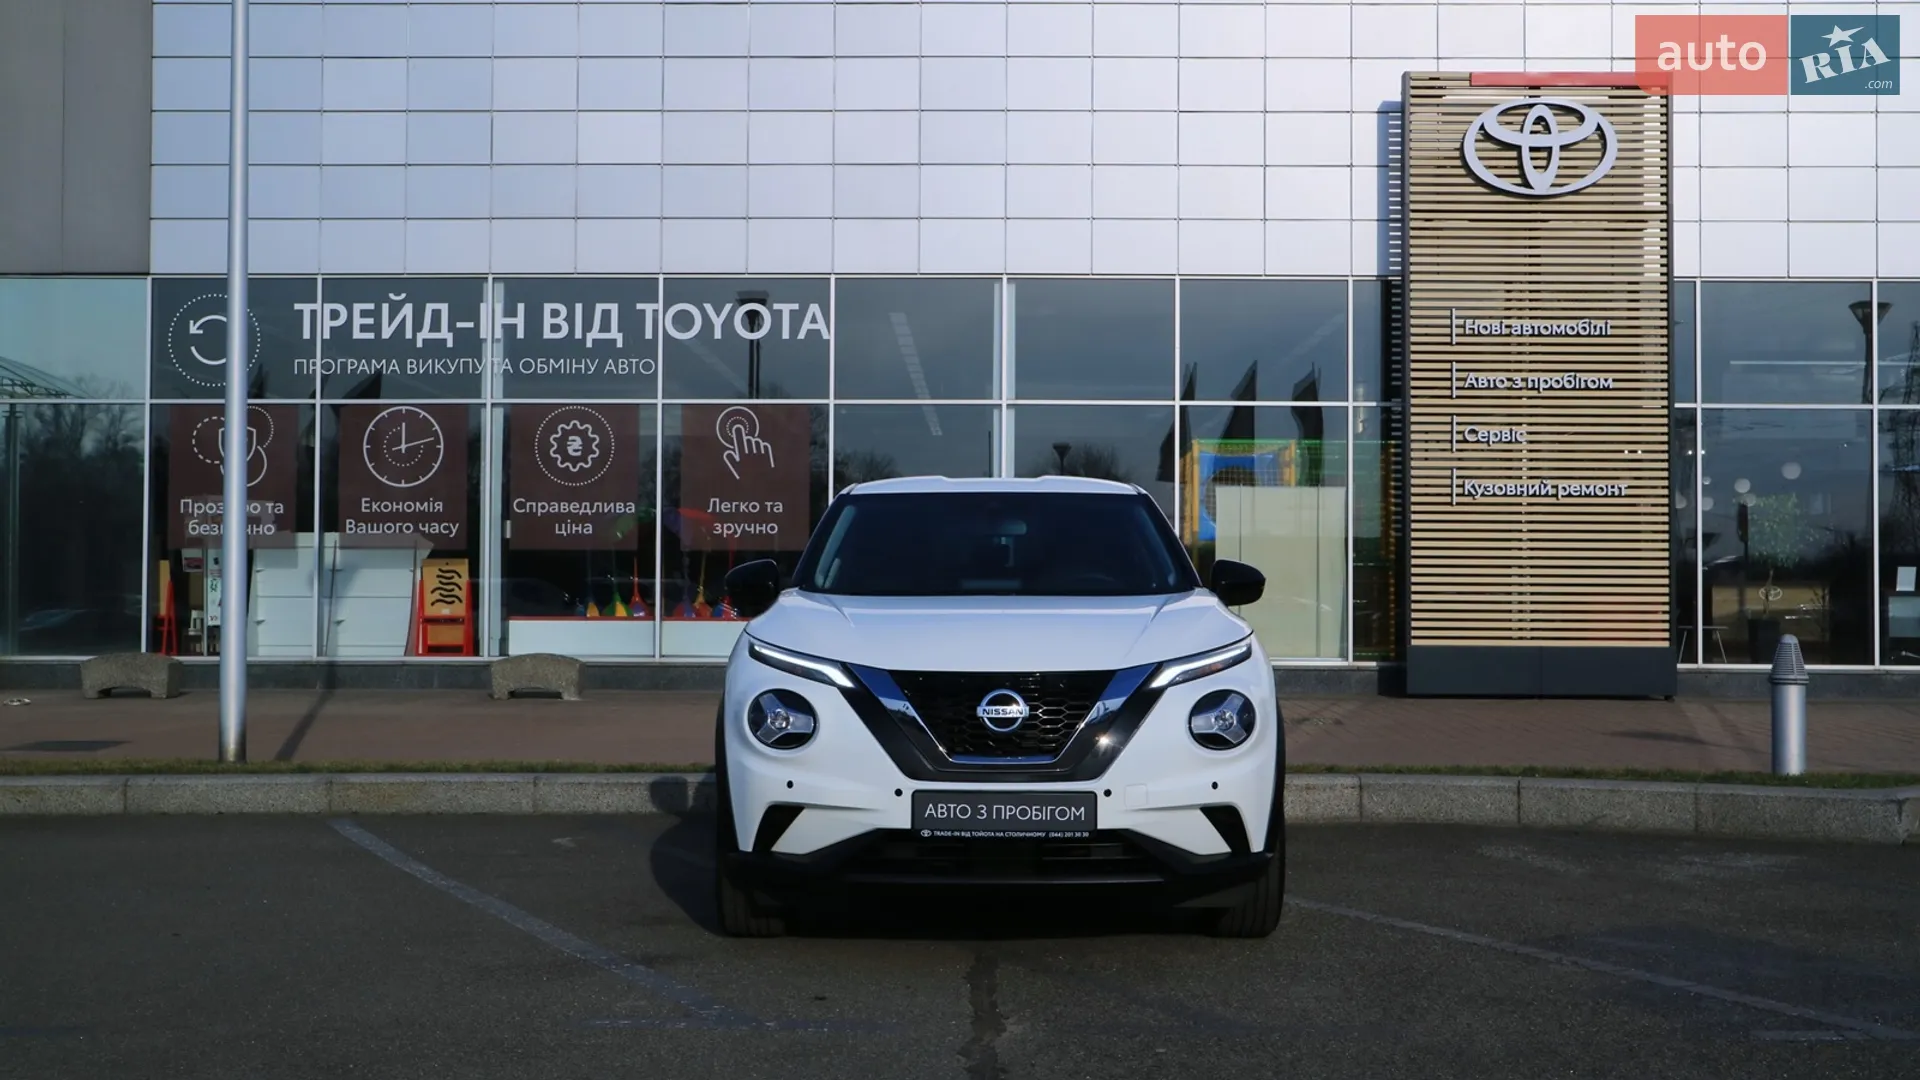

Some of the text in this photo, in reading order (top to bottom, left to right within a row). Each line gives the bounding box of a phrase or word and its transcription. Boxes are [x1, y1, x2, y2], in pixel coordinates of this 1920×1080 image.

[294, 292, 830, 348] ТРЕЙД-ІН ВІД TOYOTA
[1463, 319, 1612, 336] Нові автомобілі
[294, 358, 401, 375] ПРОГРАМА
[407, 358, 487, 375] ВИКУПУ
[519, 358, 599, 375] ОБМІНУ
[604, 358, 656, 375] АВТО
[1464, 373, 1613, 394] Авто з пробігом
[1464, 426, 1528, 446] Сервіс
[1463, 480, 1628, 501] Кузовний ремонт
[266, 502, 284, 514] та
[360, 498, 443, 513] Економія
[513, 498, 636, 516] Справедлива
[707, 498, 783, 513] Легко та
[345, 520, 459, 538] Вашого часу
[555, 520, 593, 537] ціна
[713, 521, 779, 538] зручно
[982, 708, 1024, 716] NISSAN
[924, 803, 971, 819] АВТО
[992, 805, 1085, 821] ПРОБІГОМ
